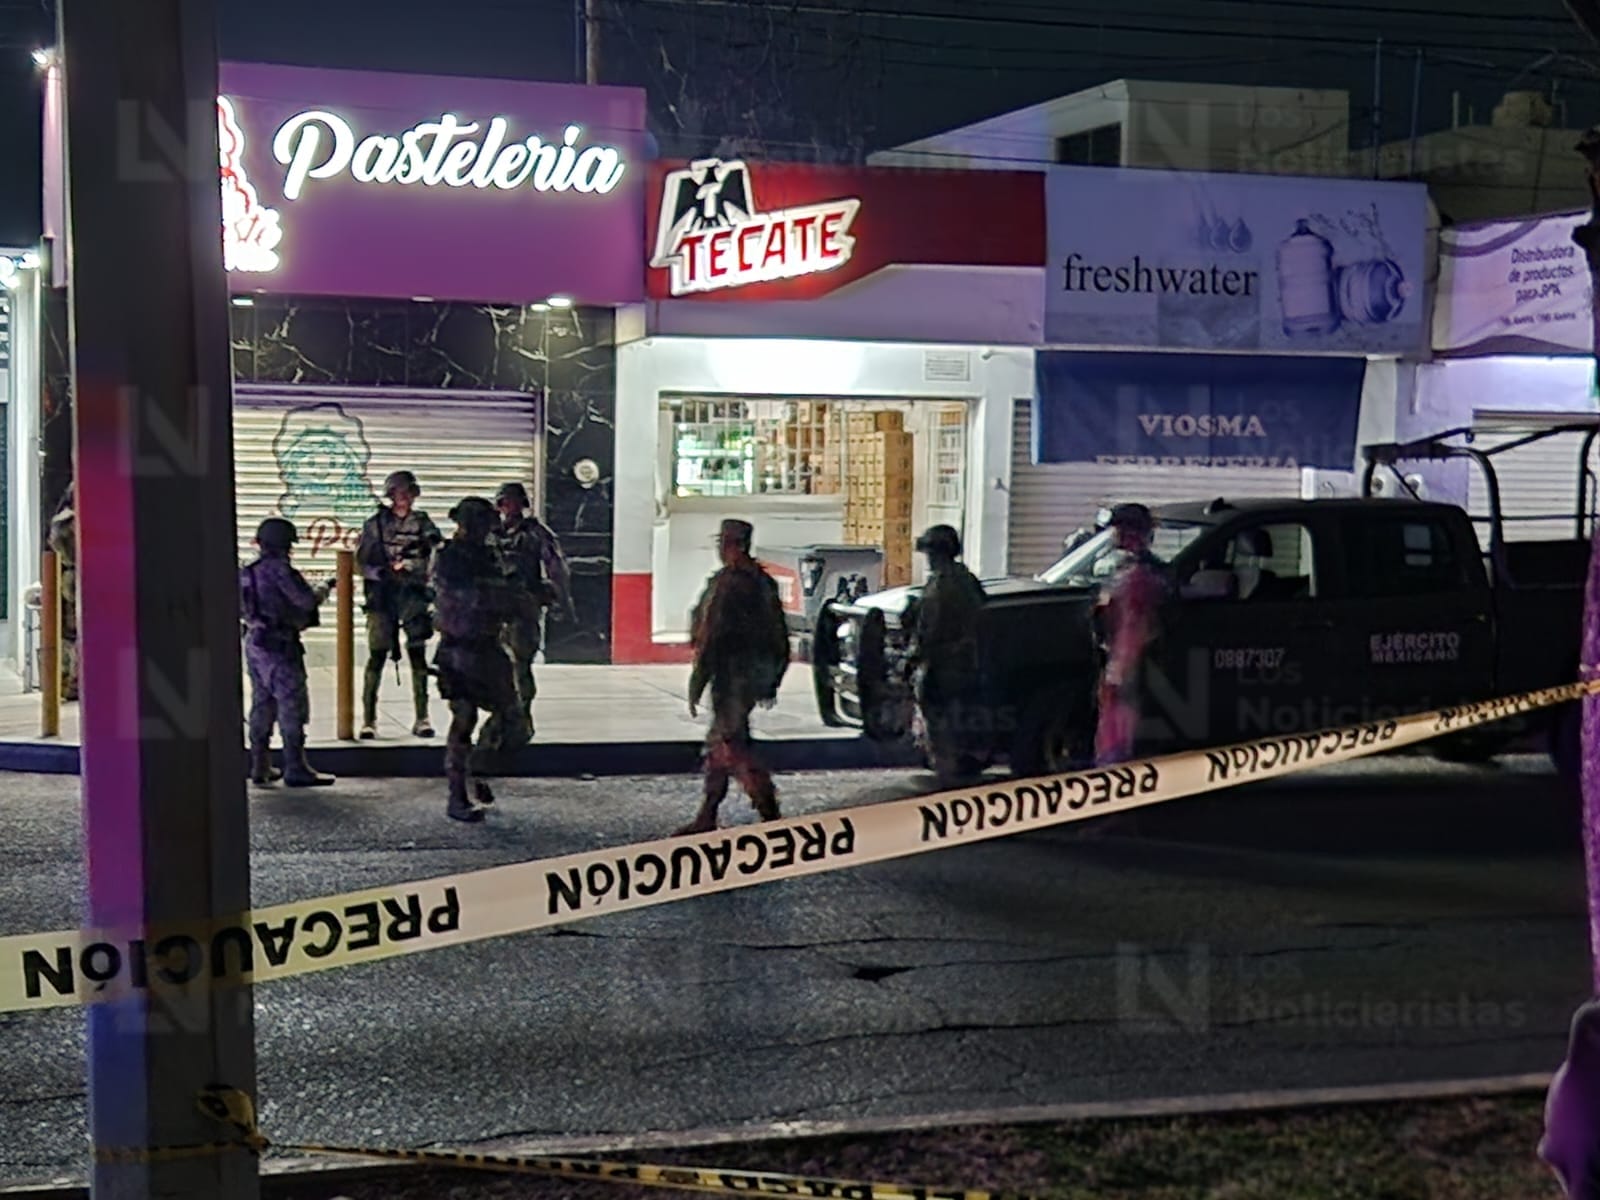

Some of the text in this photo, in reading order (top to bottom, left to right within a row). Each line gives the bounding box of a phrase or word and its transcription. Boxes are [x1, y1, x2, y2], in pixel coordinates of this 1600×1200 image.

[677, 211, 846, 281] TECATE
[1062, 253, 1260, 297] freshwater
[1138, 414, 1267, 437] VIOSMA
[918, 763, 1159, 841] PRECAUCIÓN
[545, 817, 856, 915] PRECAUCIÓN
[22, 887, 459, 998] PRECAUCIÓN
